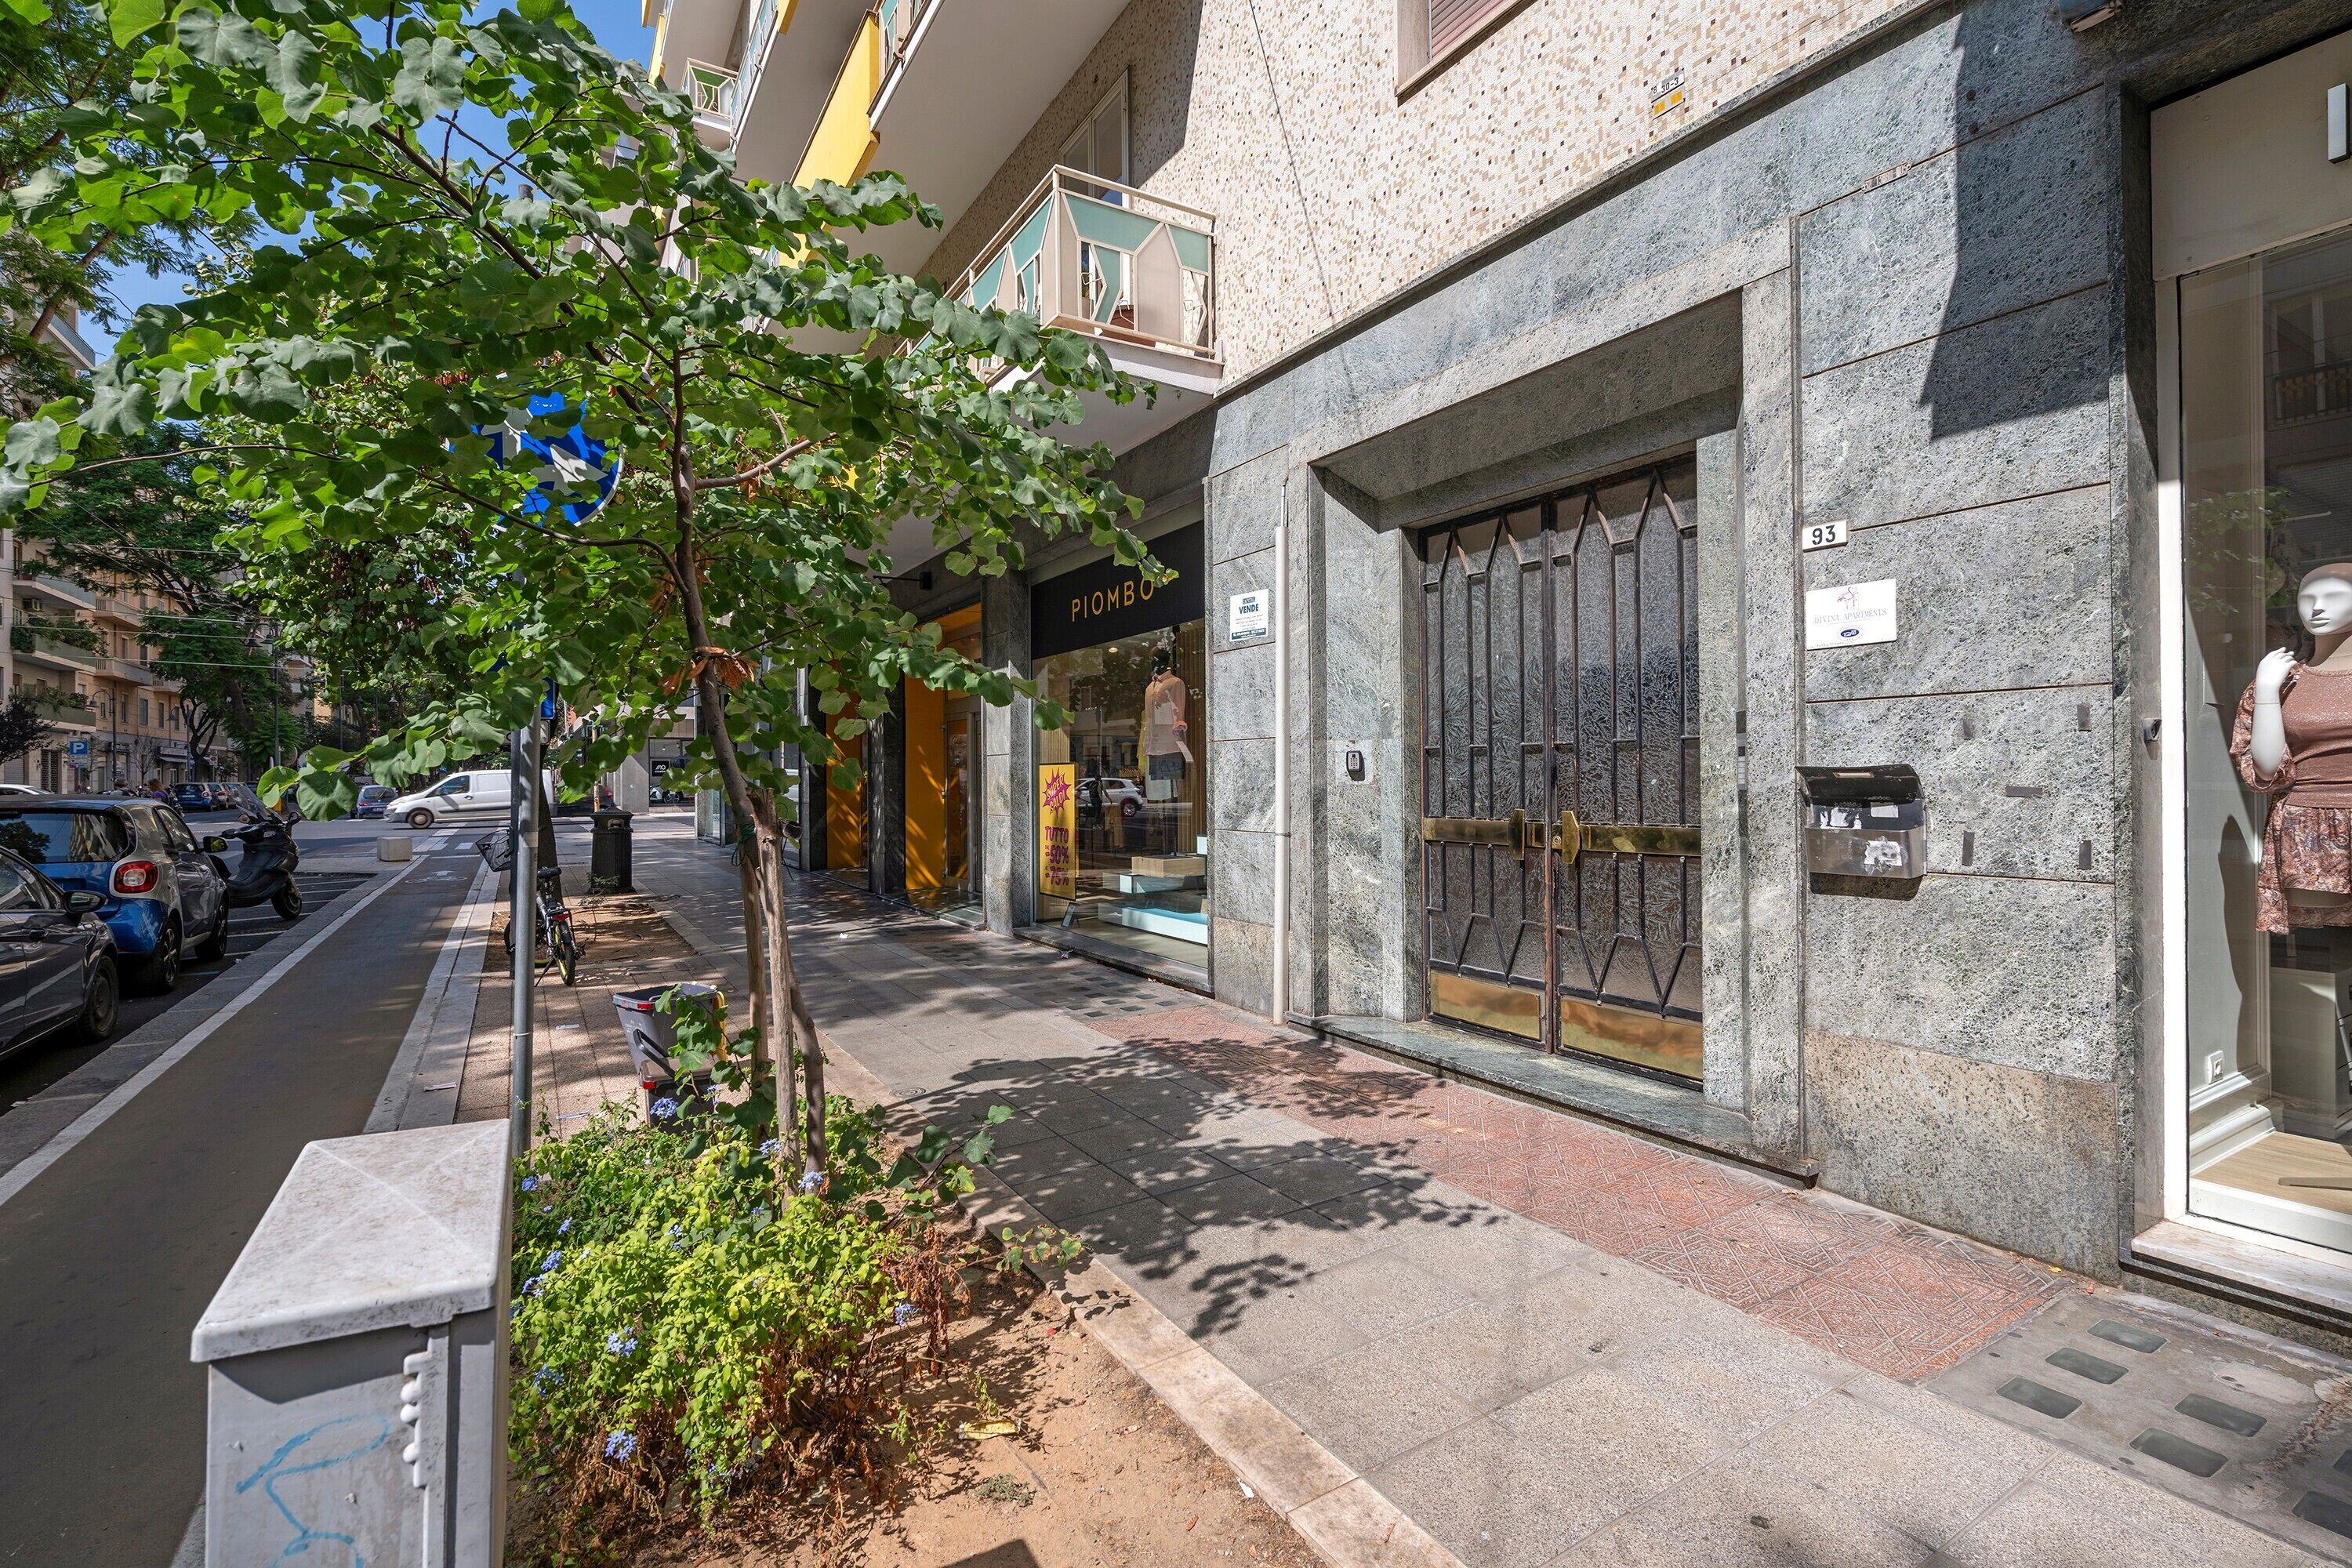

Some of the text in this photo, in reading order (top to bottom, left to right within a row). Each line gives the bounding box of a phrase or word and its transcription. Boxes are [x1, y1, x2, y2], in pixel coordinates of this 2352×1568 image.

[1812, 524, 1836, 546] 93
[1072, 578, 1155, 622] PIOMBO
[1239, 604, 1258, 614] VENDE
[1813, 608, 1888, 624] DIVINA APARTMENTS
[73, 742, 85, 753] P
[1046, 775, 1064, 800] SUPER
[1044, 826, 1069, 844] TUTTO
